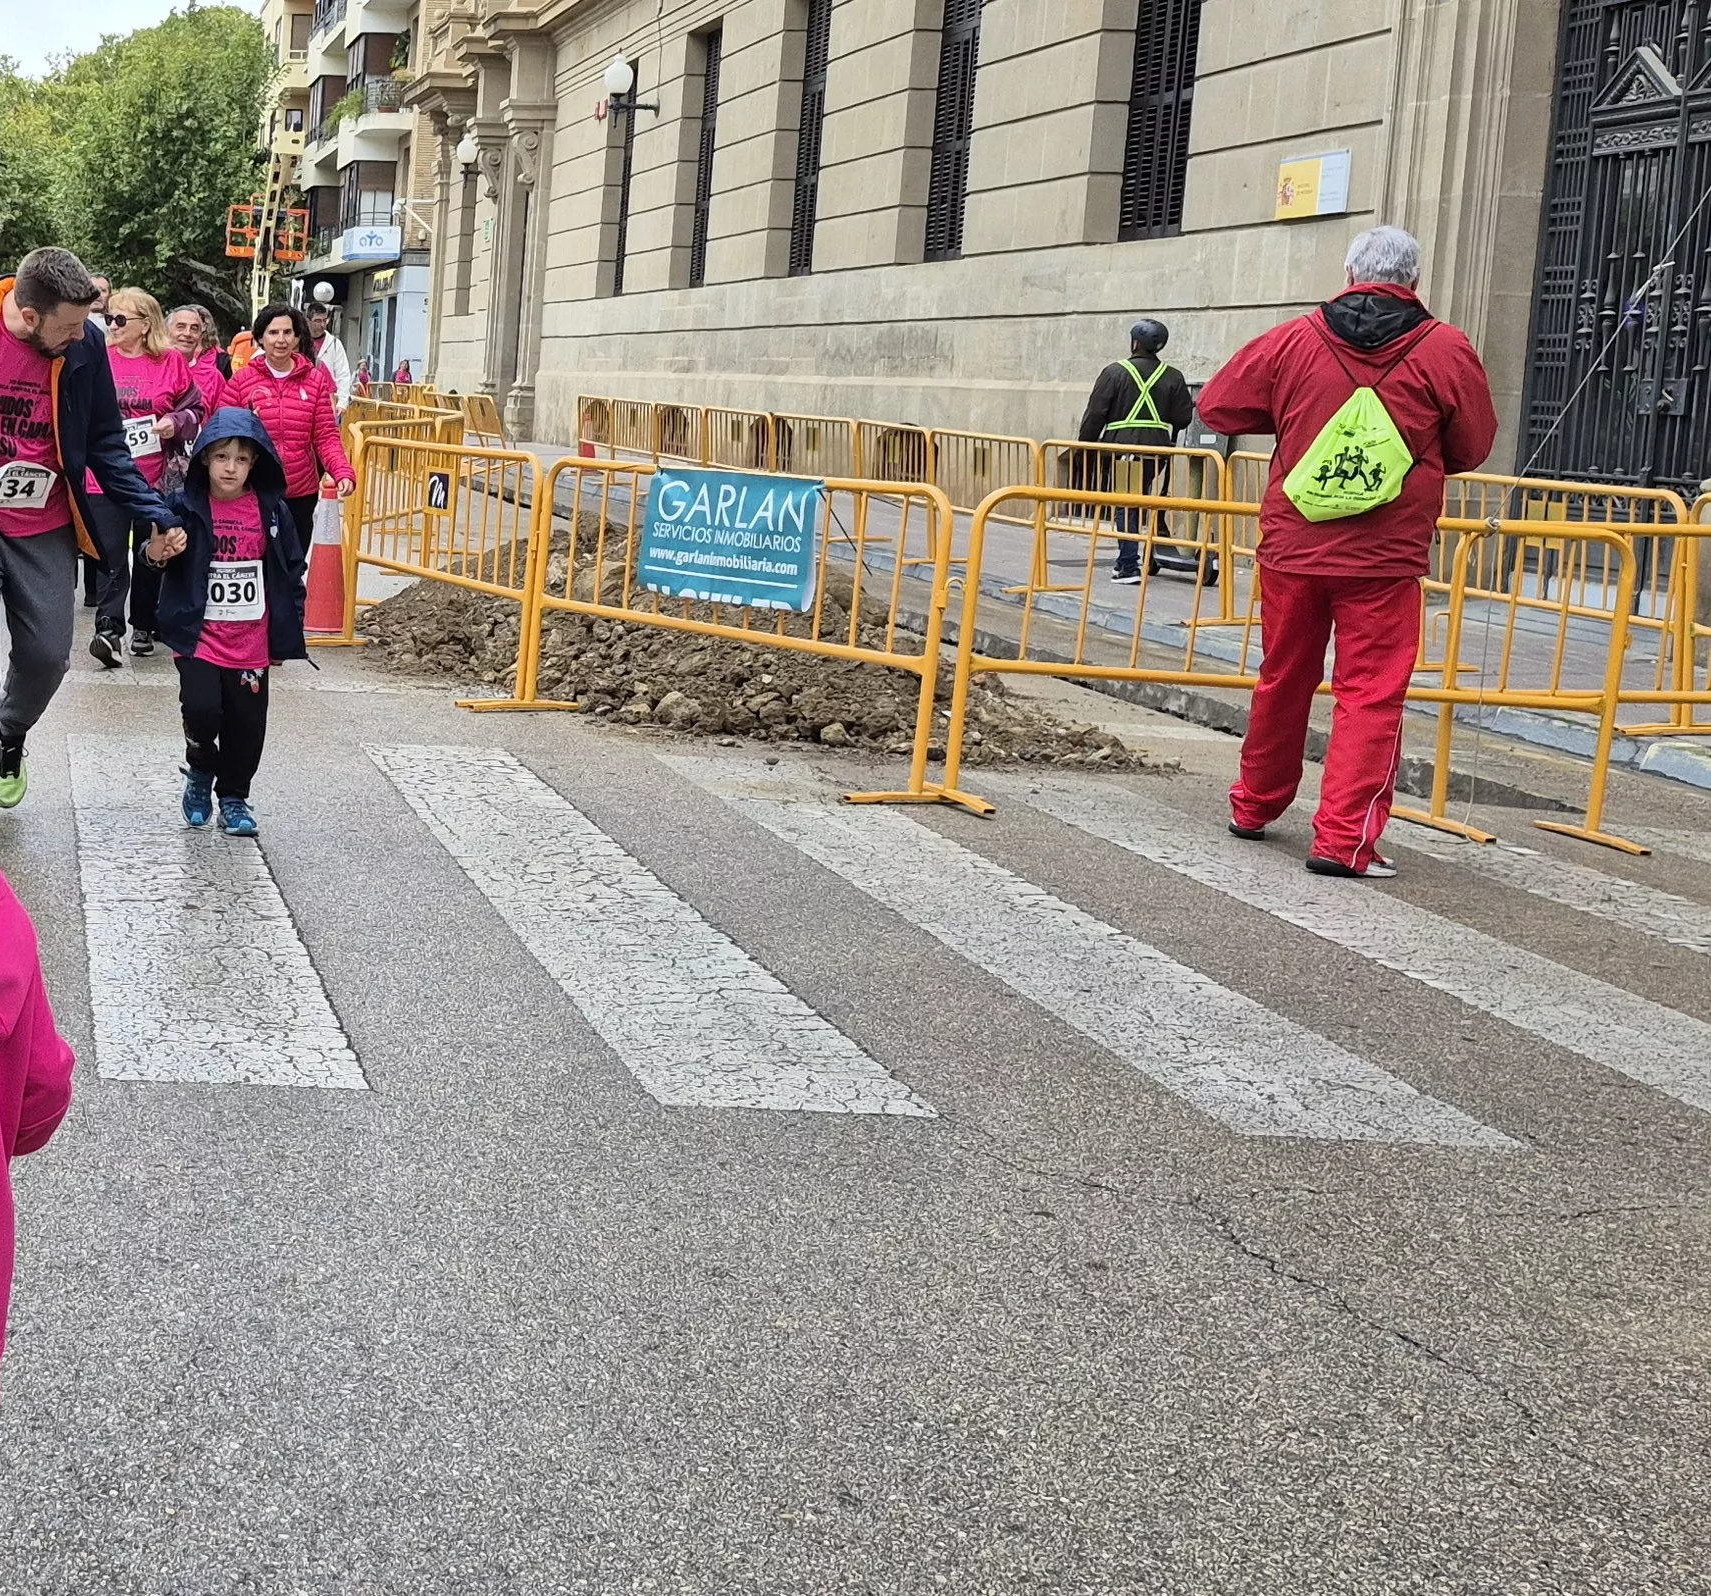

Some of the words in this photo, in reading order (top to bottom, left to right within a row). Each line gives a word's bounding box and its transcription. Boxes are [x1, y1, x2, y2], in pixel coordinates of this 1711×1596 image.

[1, 416, 17, 436] EN
[129, 430, 148, 446] 59
[658, 480, 812, 534] GARLAN
[652, 521, 713, 544] SERVICIOS
[713, 530, 802, 553] INMOBILIARIOS
[649, 546, 799, 576] www.garlaninmobiliaria.com
[210, 581, 256, 604] 030
